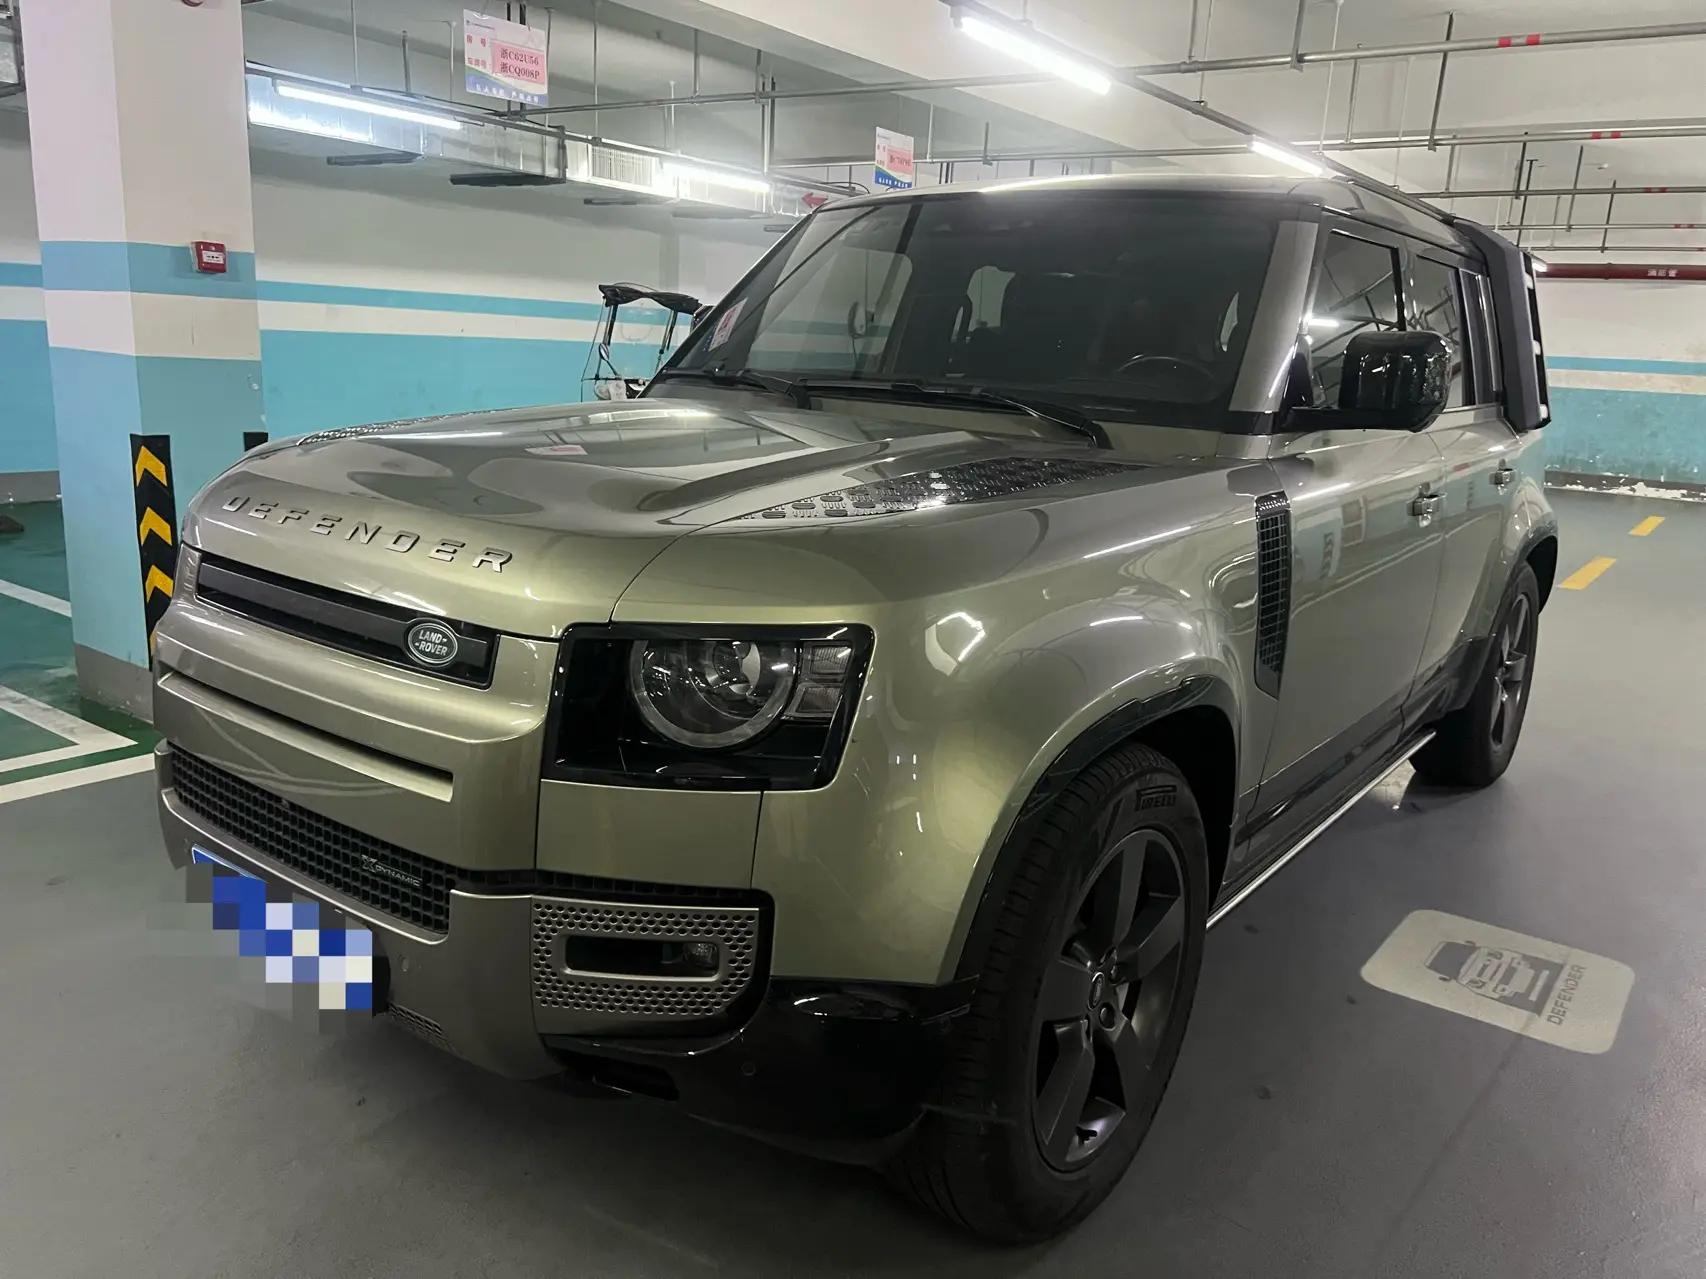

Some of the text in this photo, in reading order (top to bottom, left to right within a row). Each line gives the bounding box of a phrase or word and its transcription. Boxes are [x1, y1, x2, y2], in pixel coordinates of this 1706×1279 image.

[221, 496, 512, 573] DEFENDER
[1135, 785, 1177, 811] PIRELLI
[1546, 964, 1587, 1026] DEFENDER
